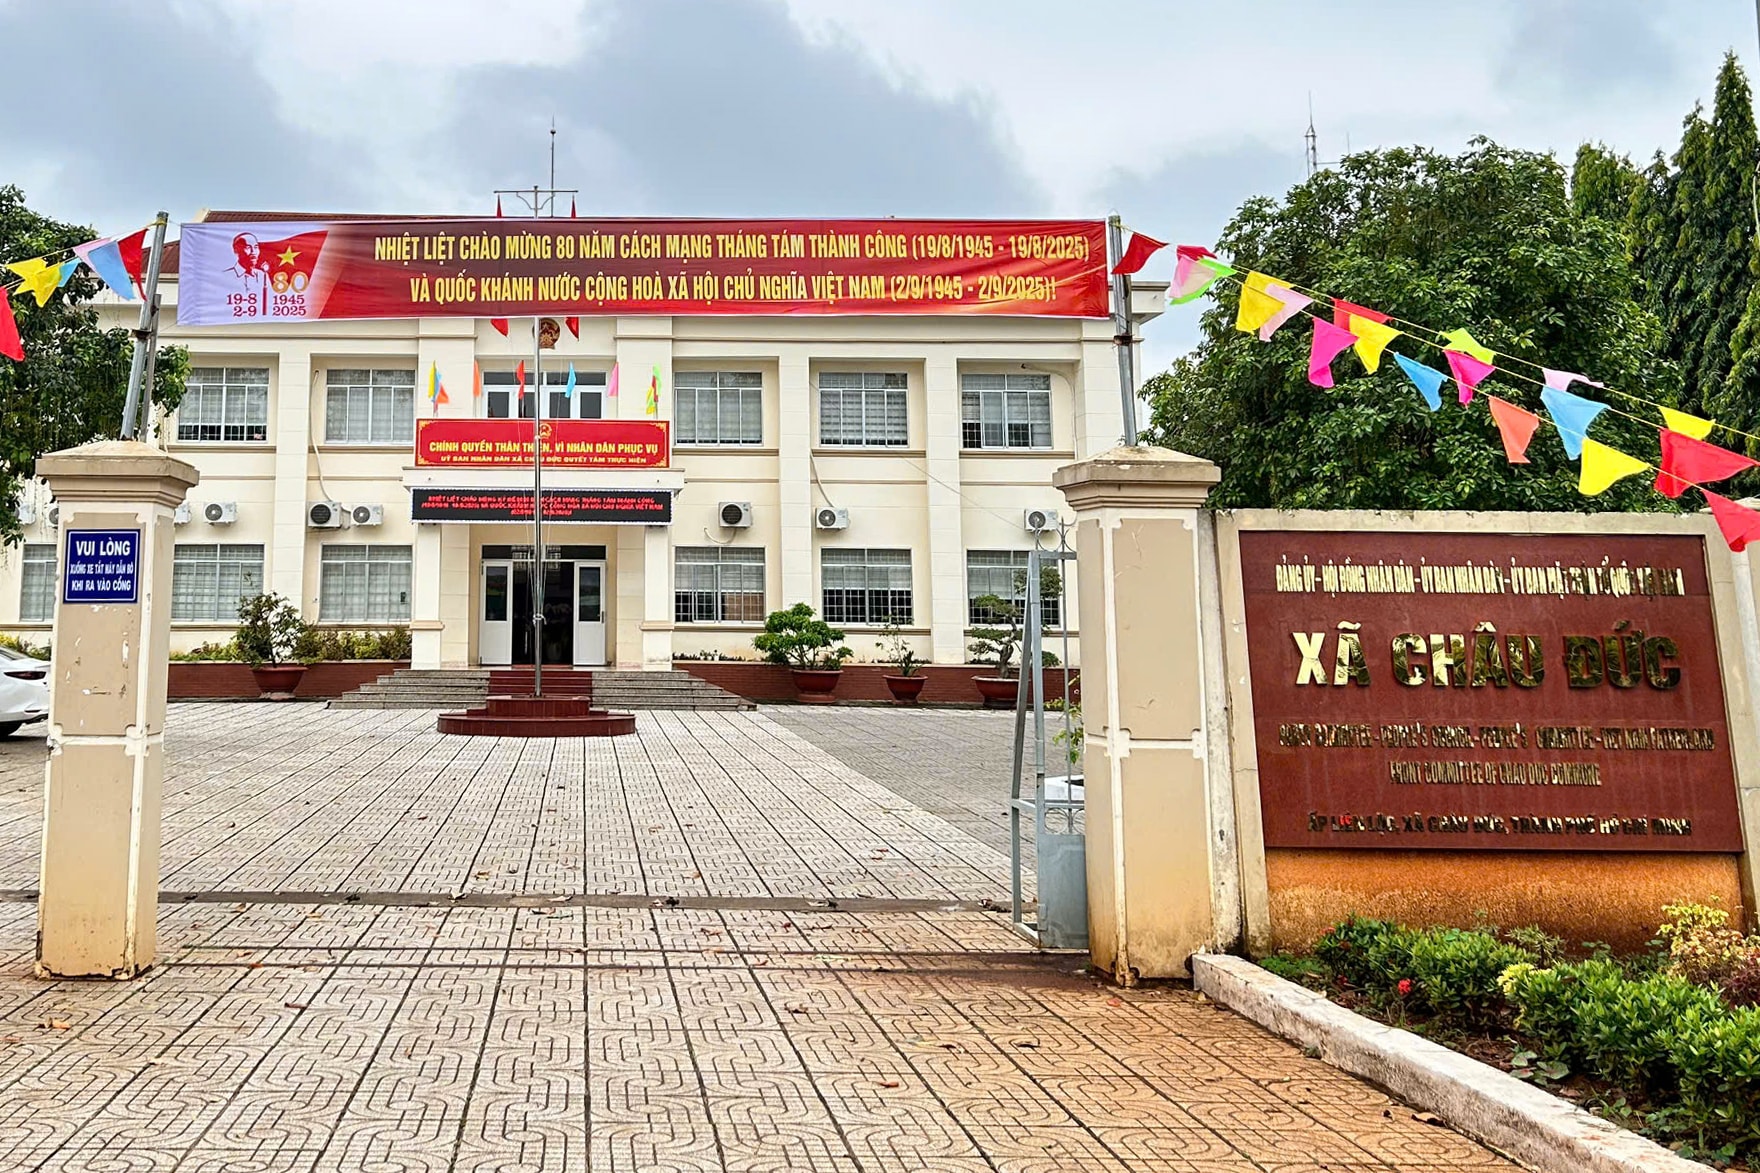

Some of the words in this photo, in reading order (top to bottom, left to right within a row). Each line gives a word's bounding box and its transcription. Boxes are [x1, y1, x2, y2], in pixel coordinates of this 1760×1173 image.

[374, 232, 420, 266] NHIỆT
[424, 231, 456, 266] LIỆT
[460, 231, 500, 260] CHÀO
[505, 230, 552, 260] MỪNG
[556, 235, 575, 259] 80
[579, 230, 615, 259] NĂM
[620, 230, 661, 259] CÁCH
[666, 234, 712, 264] MẠNG
[716, 230, 767, 258] THÁNG
[771, 230, 805, 258] TÁM
[809, 230, 860, 258] THÀNH
[864, 230, 908, 258] CÔNG
[912, 234, 994, 260] (19/8/1945
[1008, 235, 1090, 262] 19/8/2025)
[272, 272, 309, 294] 80
[410, 272, 430, 302] VÀ
[434, 269, 476, 305] QUỐC
[480, 272, 534, 302] KHÁNH
[538, 272, 580, 301] NƯỚC
[586, 272, 628, 306] CỘNG
[632, 271, 663, 300] HOÀ
[668, 271, 689, 300] XÃ
[694, 270, 719, 305] HỘI
[724, 268, 755, 299] CHỦ
[760, 270, 807, 300] NGHĨA
[811, 270, 844, 305] VIỆT
[848, 275, 885, 300] NAM
[890, 275, 963, 302] (2/9/1945
[978, 276, 1057, 303] 2/9/2025)!
[226, 294, 257, 305] 19-8
[273, 295, 305, 305] 1945
[234, 306, 257, 317] 2-9
[272, 306, 306, 316] 2025
[430, 440, 459, 452] CHÍNH
[495, 440, 520, 452] THÂN
[556, 440, 564, 453] VÌ
[566, 441, 593, 453] NHÂN
[596, 442, 616, 453] DÂN
[618, 444, 643, 455] PHỤC
[646, 444, 658, 456] VỤ
[76, 540, 96, 556] VUI
[100, 536, 131, 556] LÒNG
[87, 564, 94, 575] XE
[1276, 554, 1303, 592] ĐẢNG
[1322, 559, 1339, 598] HỘI
[1339, 557, 1366, 593] ĐỒNG
[1366, 559, 1394, 593] NHÂN
[1394, 559, 1415, 593] DÂN
[1434, 566, 1456, 593] BAN
[1454, 560, 1484, 593] NHÂN
[1483, 560, 1505, 594] DÂN
[1525, 566, 1548, 594] BAN
[72, 580, 84, 591] KHI
[86, 580, 95, 591] RA
[97, 577, 111, 591] VÀO
[1292, 620, 1373, 686] XÃ
[1392, 621, 1546, 688] CHÂU
[1563, 619, 1682, 689] ĐỨC
[1380, 722, 1428, 748] PEOPLE'S
[1390, 760, 1422, 784] FRONT
[1424, 761, 1483, 785] COMMITTEE
[1484, 762, 1498, 785] OF
[1500, 762, 1527, 785] CHAU
[1528, 762, 1549, 786] DUC
[1402, 811, 1424, 833] XÃ
